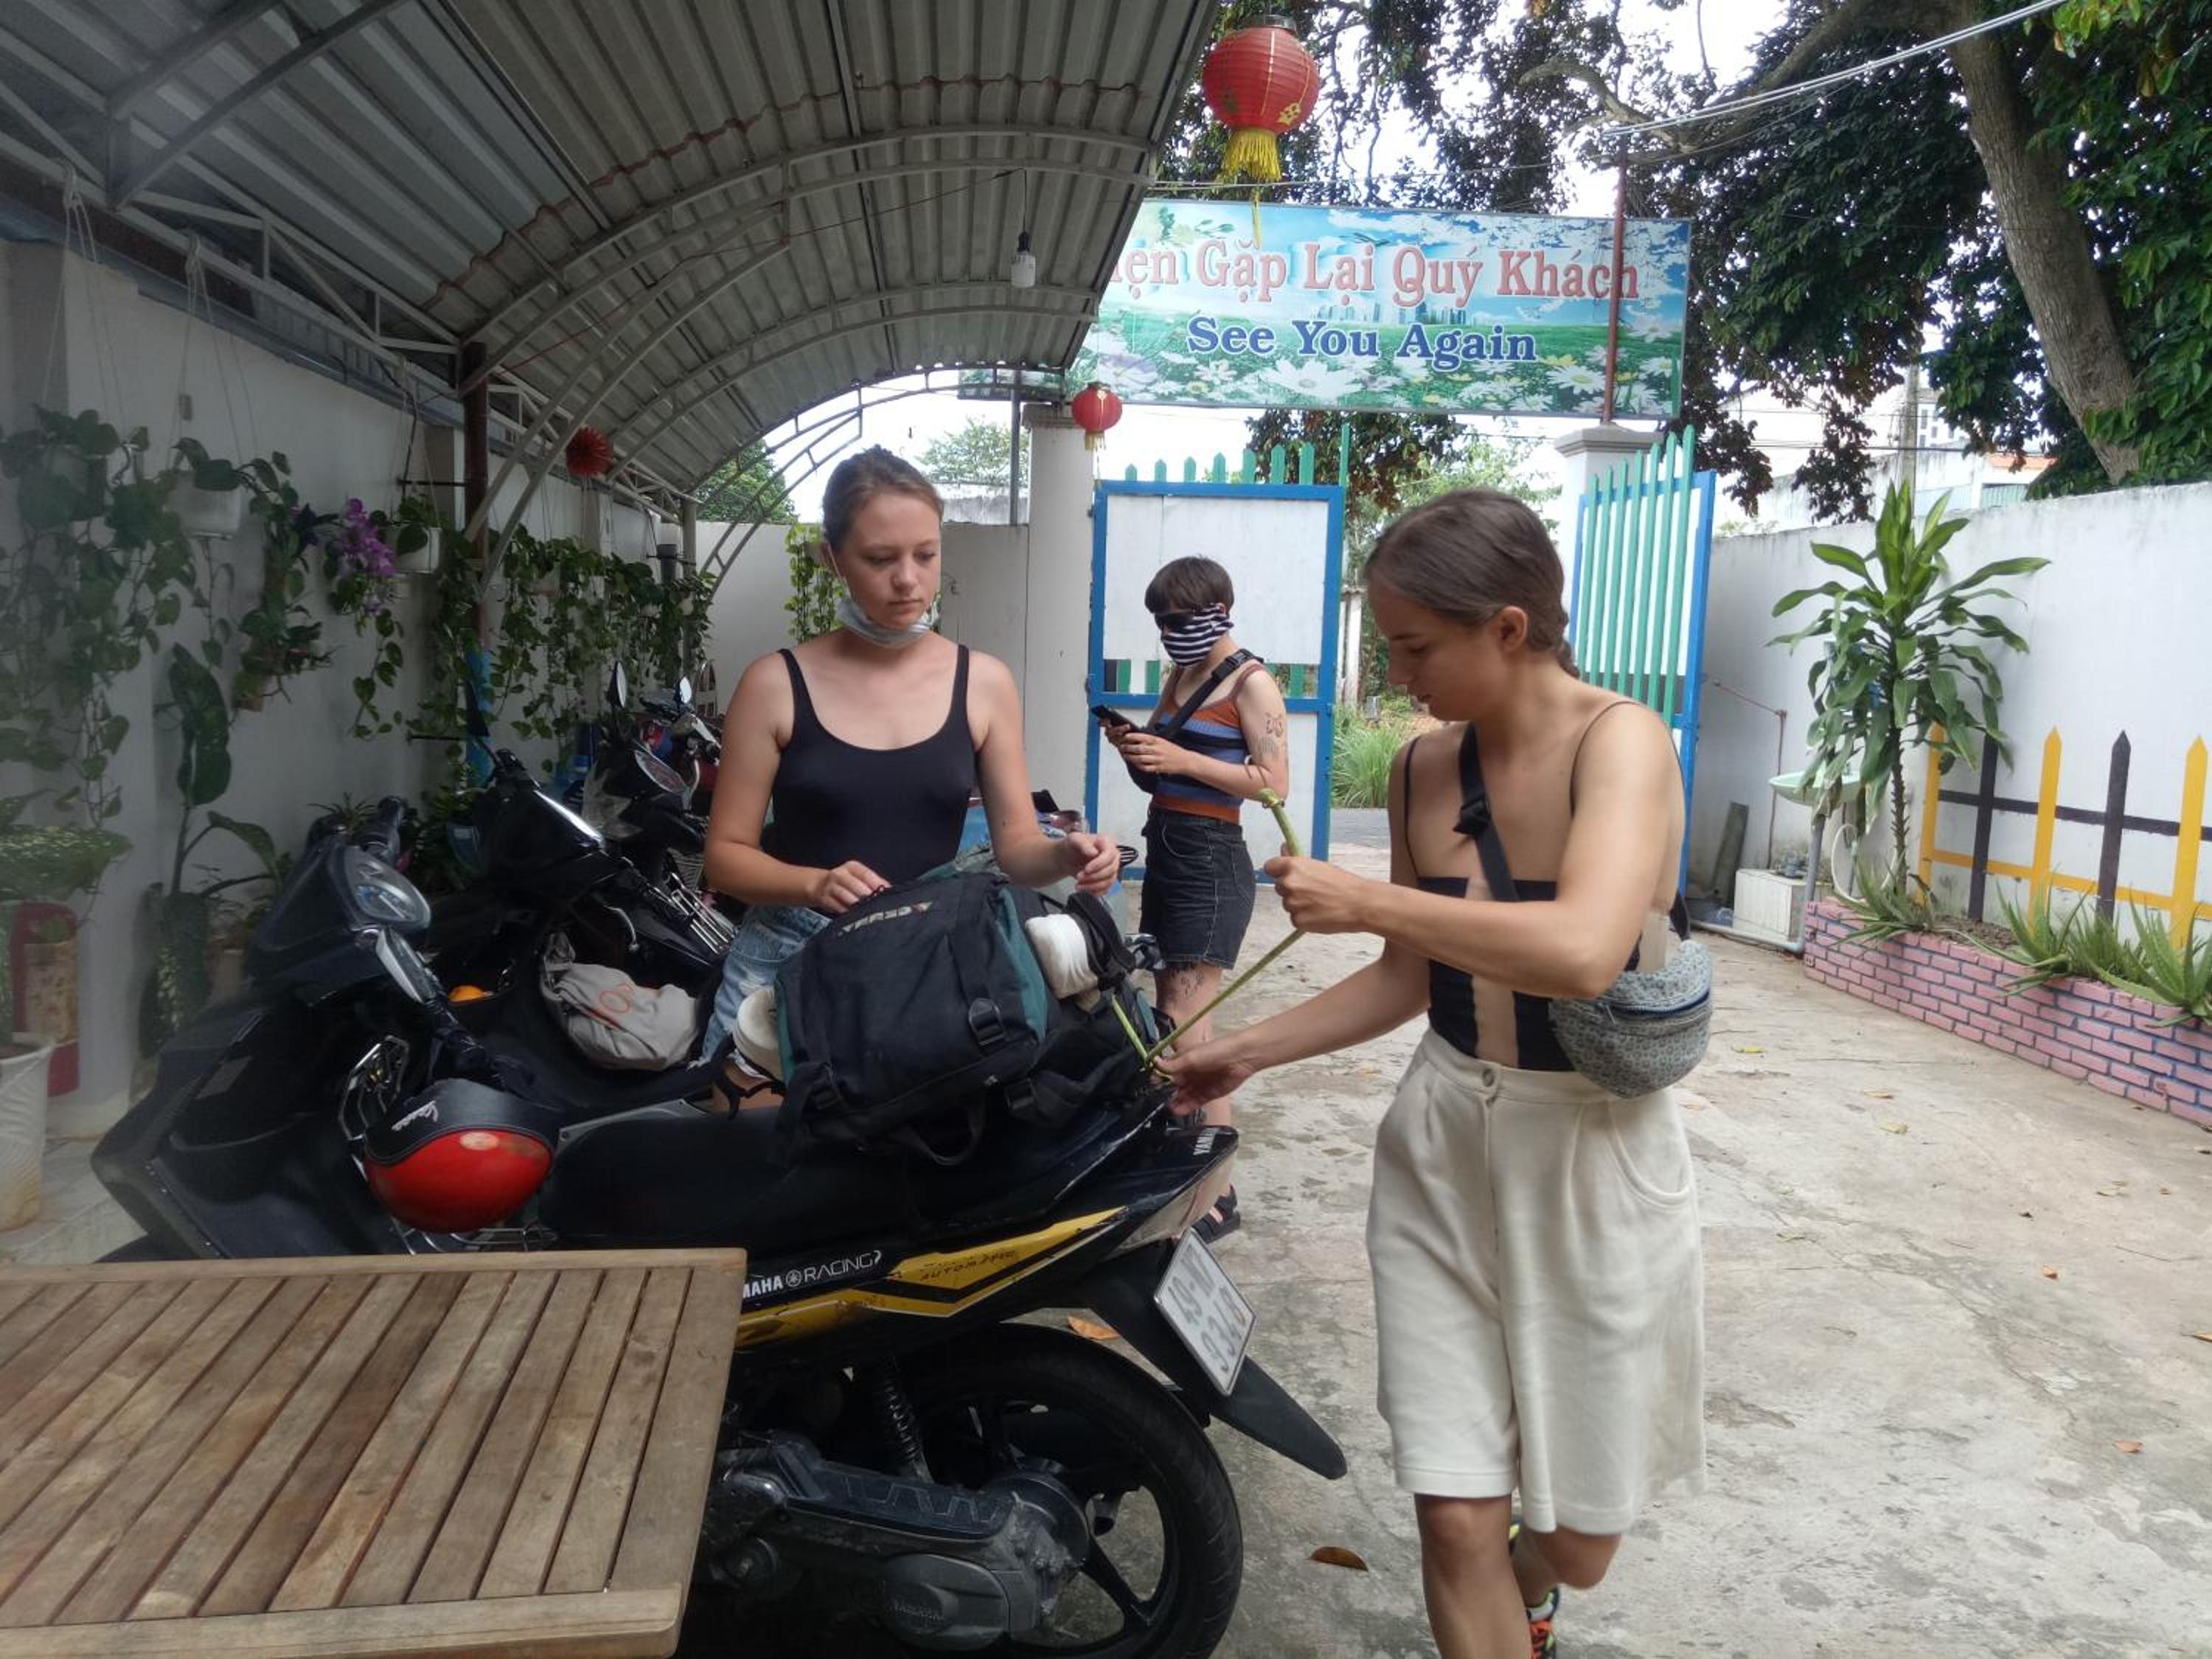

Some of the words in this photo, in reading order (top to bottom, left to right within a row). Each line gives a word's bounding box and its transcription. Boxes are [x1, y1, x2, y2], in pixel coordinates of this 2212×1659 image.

[1197, 238, 1287, 302] Gặp
[1304, 243, 1375, 305] Lại
[1393, 245, 1484, 307] Quý
[1187, 316, 1274, 354] See
[1292, 319, 1379, 357] You
[1396, 323, 1537, 372] Again
[804, 1252, 873, 1283] RACING
